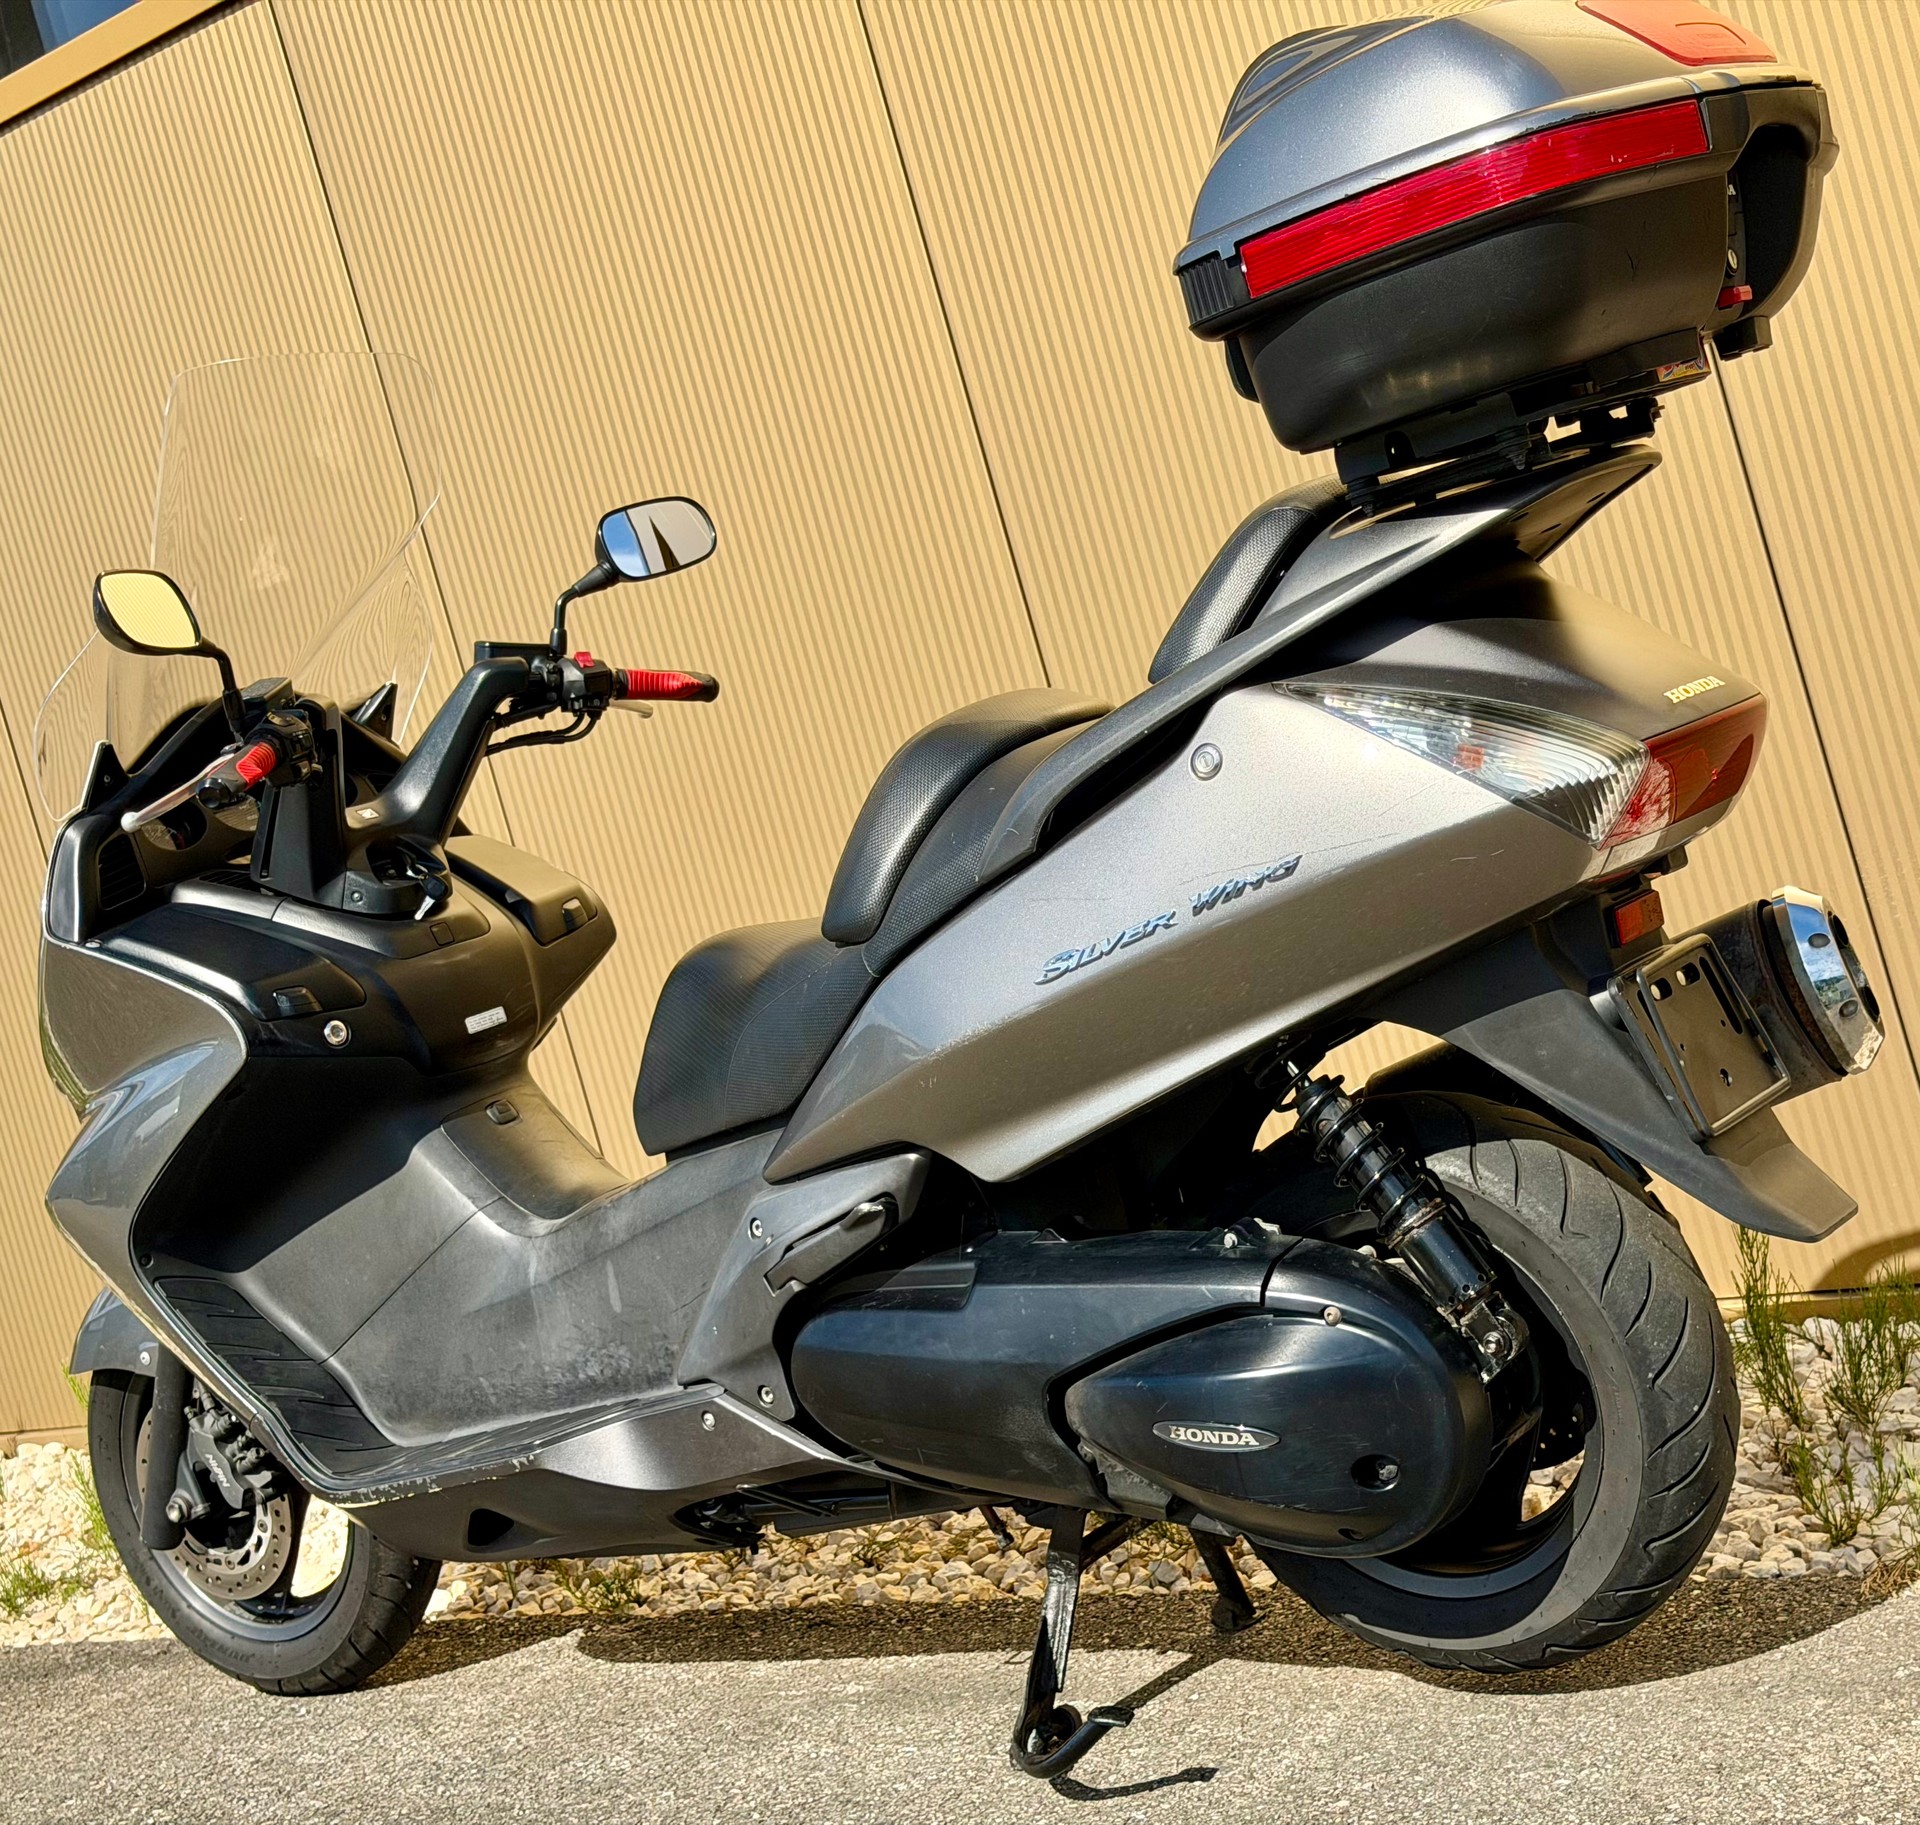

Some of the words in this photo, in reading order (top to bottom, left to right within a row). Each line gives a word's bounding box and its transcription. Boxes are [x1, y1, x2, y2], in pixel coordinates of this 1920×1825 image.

[1663, 675, 1726, 704] HONDA
[1033, 909, 1179, 985] SILVER
[1188, 854, 1303, 917] WING
[1168, 1425, 1260, 1446] HONDA
